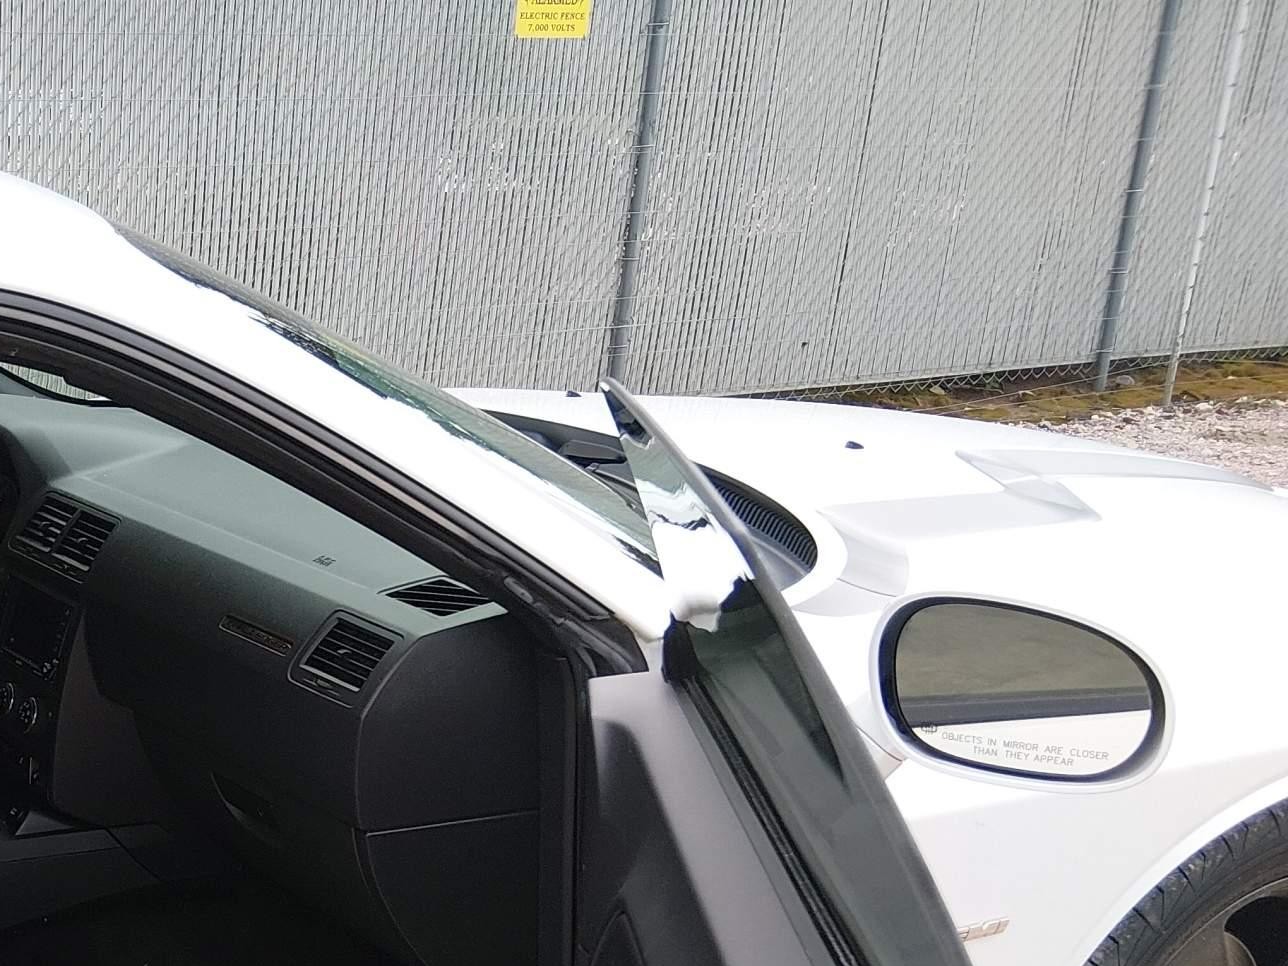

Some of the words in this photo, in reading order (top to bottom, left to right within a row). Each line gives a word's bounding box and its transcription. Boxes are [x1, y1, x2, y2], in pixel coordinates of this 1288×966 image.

[520, 12, 559, 20] ELECTRIC
[560, 12, 585, 20] FENCE
[528, 24, 549, 32] 7,000
[551, 24, 576, 32] VOLTS
[941, 731, 983, 745] OBJECTS
[987, 737, 997, 746] IN
[1003, 740, 1039, 752] MIRROR
[1044, 745, 1064, 755] ARE
[1069, 748, 1110, 761] CLOSER
[973, 746, 998, 757] THAN
[1005, 750, 1030, 761] THEY
[1033, 754, 1074, 767] APPEAR
